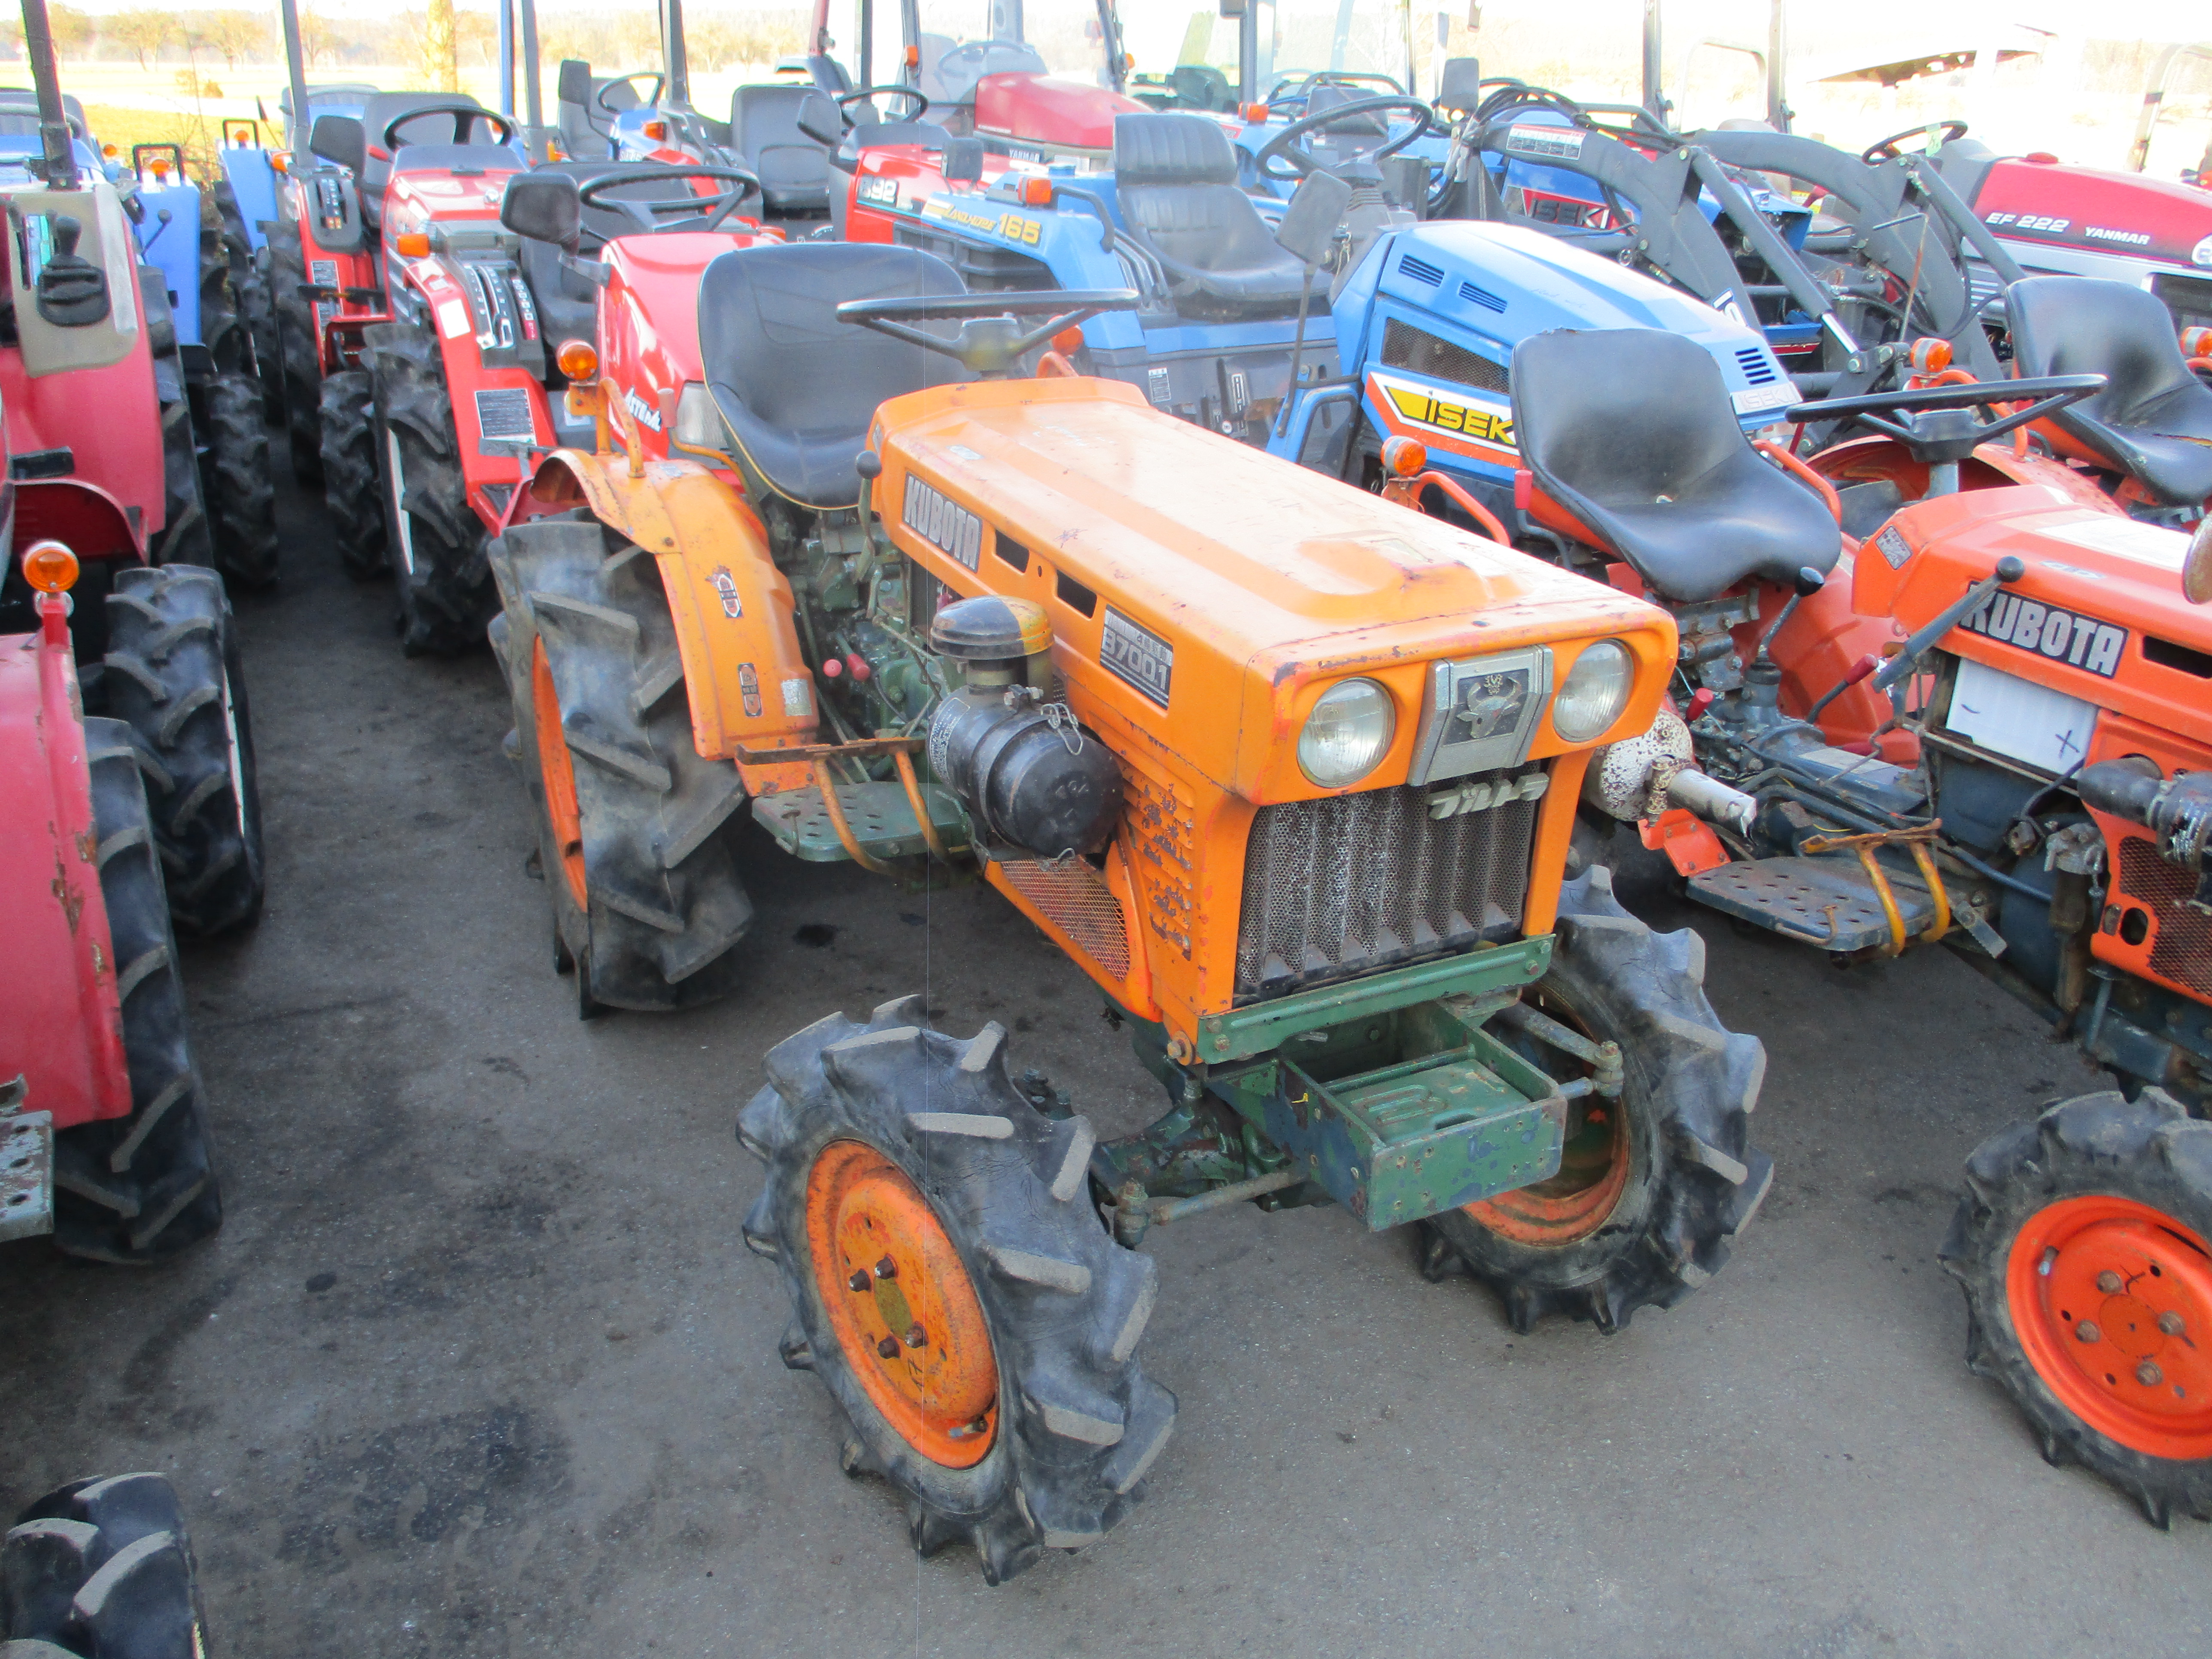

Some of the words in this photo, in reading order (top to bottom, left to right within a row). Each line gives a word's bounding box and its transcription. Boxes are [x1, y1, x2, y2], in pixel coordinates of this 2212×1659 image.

[1010, 149, 1040, 163] YANMAR
[999, 213, 1042, 244] 165
[1529, 198, 1610, 229] ISEKI
[1985, 212, 2017, 225] EF
[2016, 215, 2070, 233] 222
[2084, 226, 2151, 245] YANMAR
[904, 476, 980, 570] KUBOTA
[1960, 584, 2124, 677] KUBOTA
[1101, 626, 1167, 690] B7001
